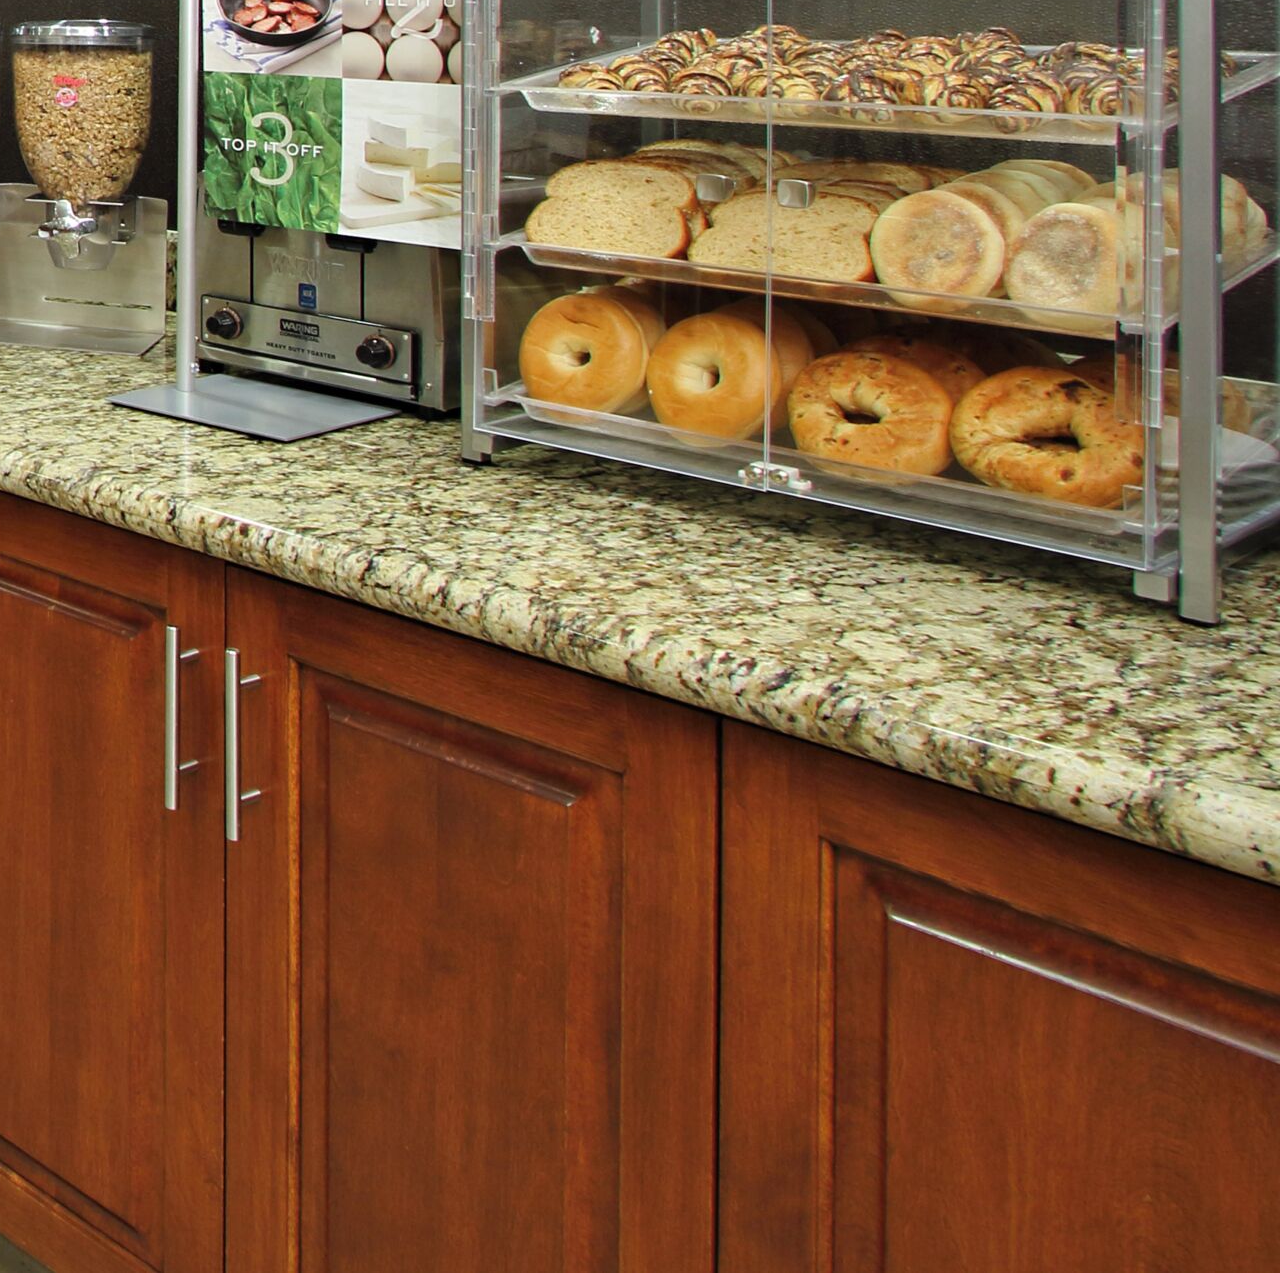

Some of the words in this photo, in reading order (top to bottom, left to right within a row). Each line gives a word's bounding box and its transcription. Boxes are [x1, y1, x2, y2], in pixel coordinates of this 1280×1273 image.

[221, 137, 257, 152] TOP
[263, 141, 279, 154] IT
[286, 143, 324, 158] OFF
[250, 111, 294, 186] 3
[281, 320, 319, 336] WARING
[266, 342, 286, 350] HEAVY
[288, 345, 305, 353] DUTY
[307, 349, 336, 360] TOASTER
